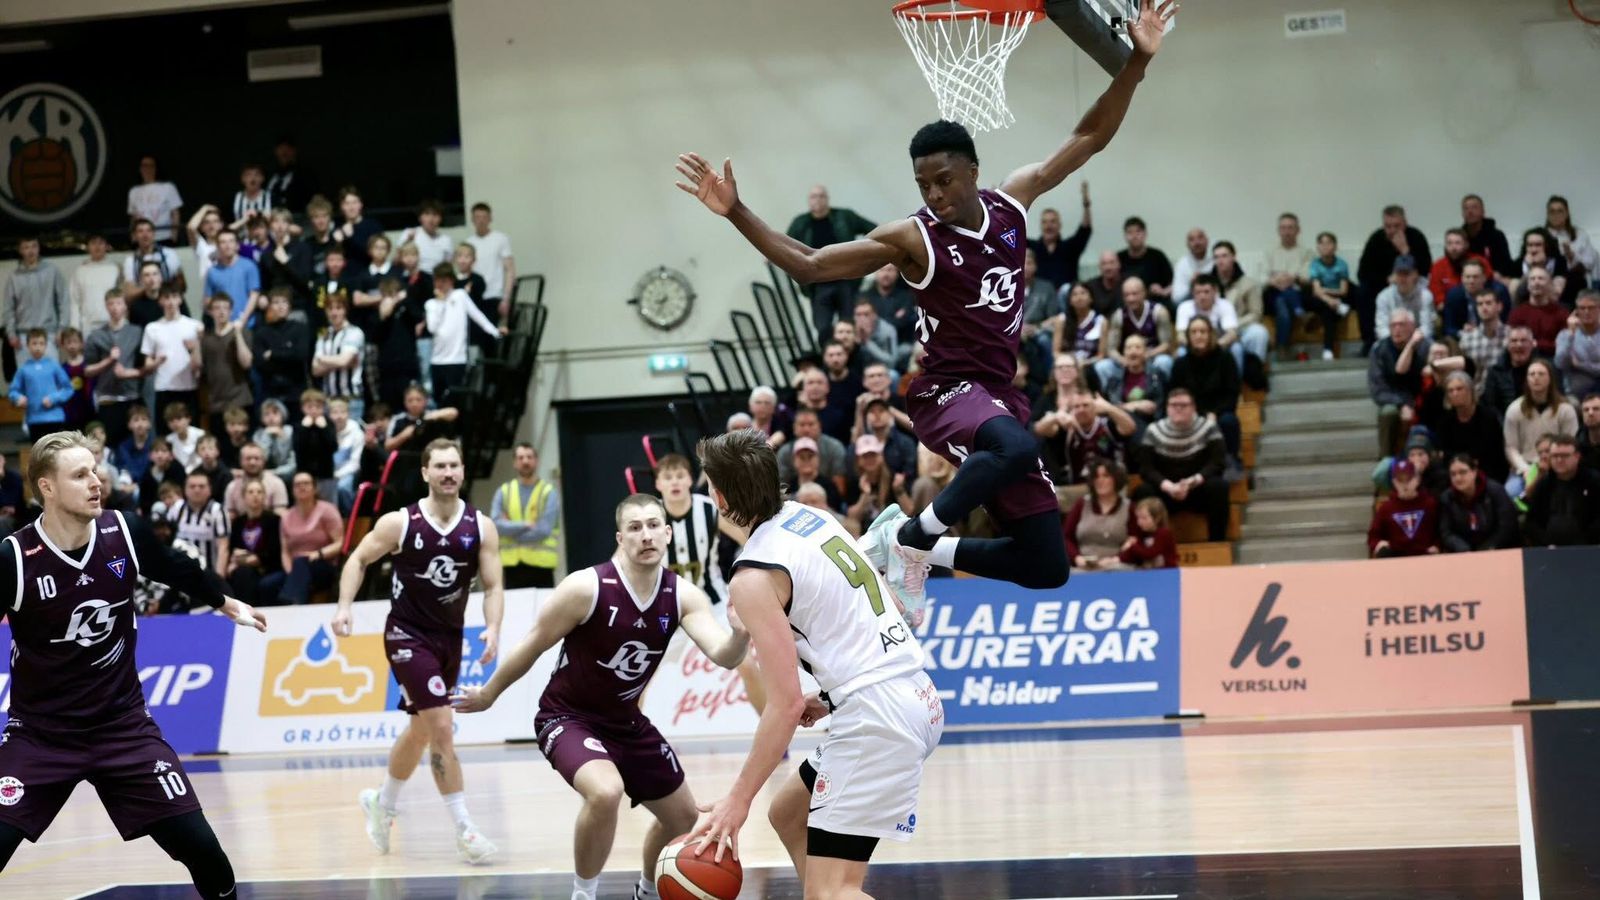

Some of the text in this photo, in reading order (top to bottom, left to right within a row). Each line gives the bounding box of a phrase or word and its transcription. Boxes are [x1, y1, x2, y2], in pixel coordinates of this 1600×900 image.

[947, 244, 964, 266] 5
[414, 532, 424, 550] 6
[36, 575, 57, 600] 10
[820, 535, 886, 617] 9
[608, 606, 619, 627] 7
[916, 597, 1150, 637] ÍLALEIGA
[1367, 601, 1481, 627] FREMST
[917, 630, 1159, 670] KUREYRAR
[1365, 631, 1485, 657] Í HEILSU
[960, 676, 1062, 706] Höldur
[1221, 679, 1307, 692] VERSLUN
[666, 752, 679, 773] 7
[158, 772, 187, 800] 10
[896, 823, 915, 834] Kris
